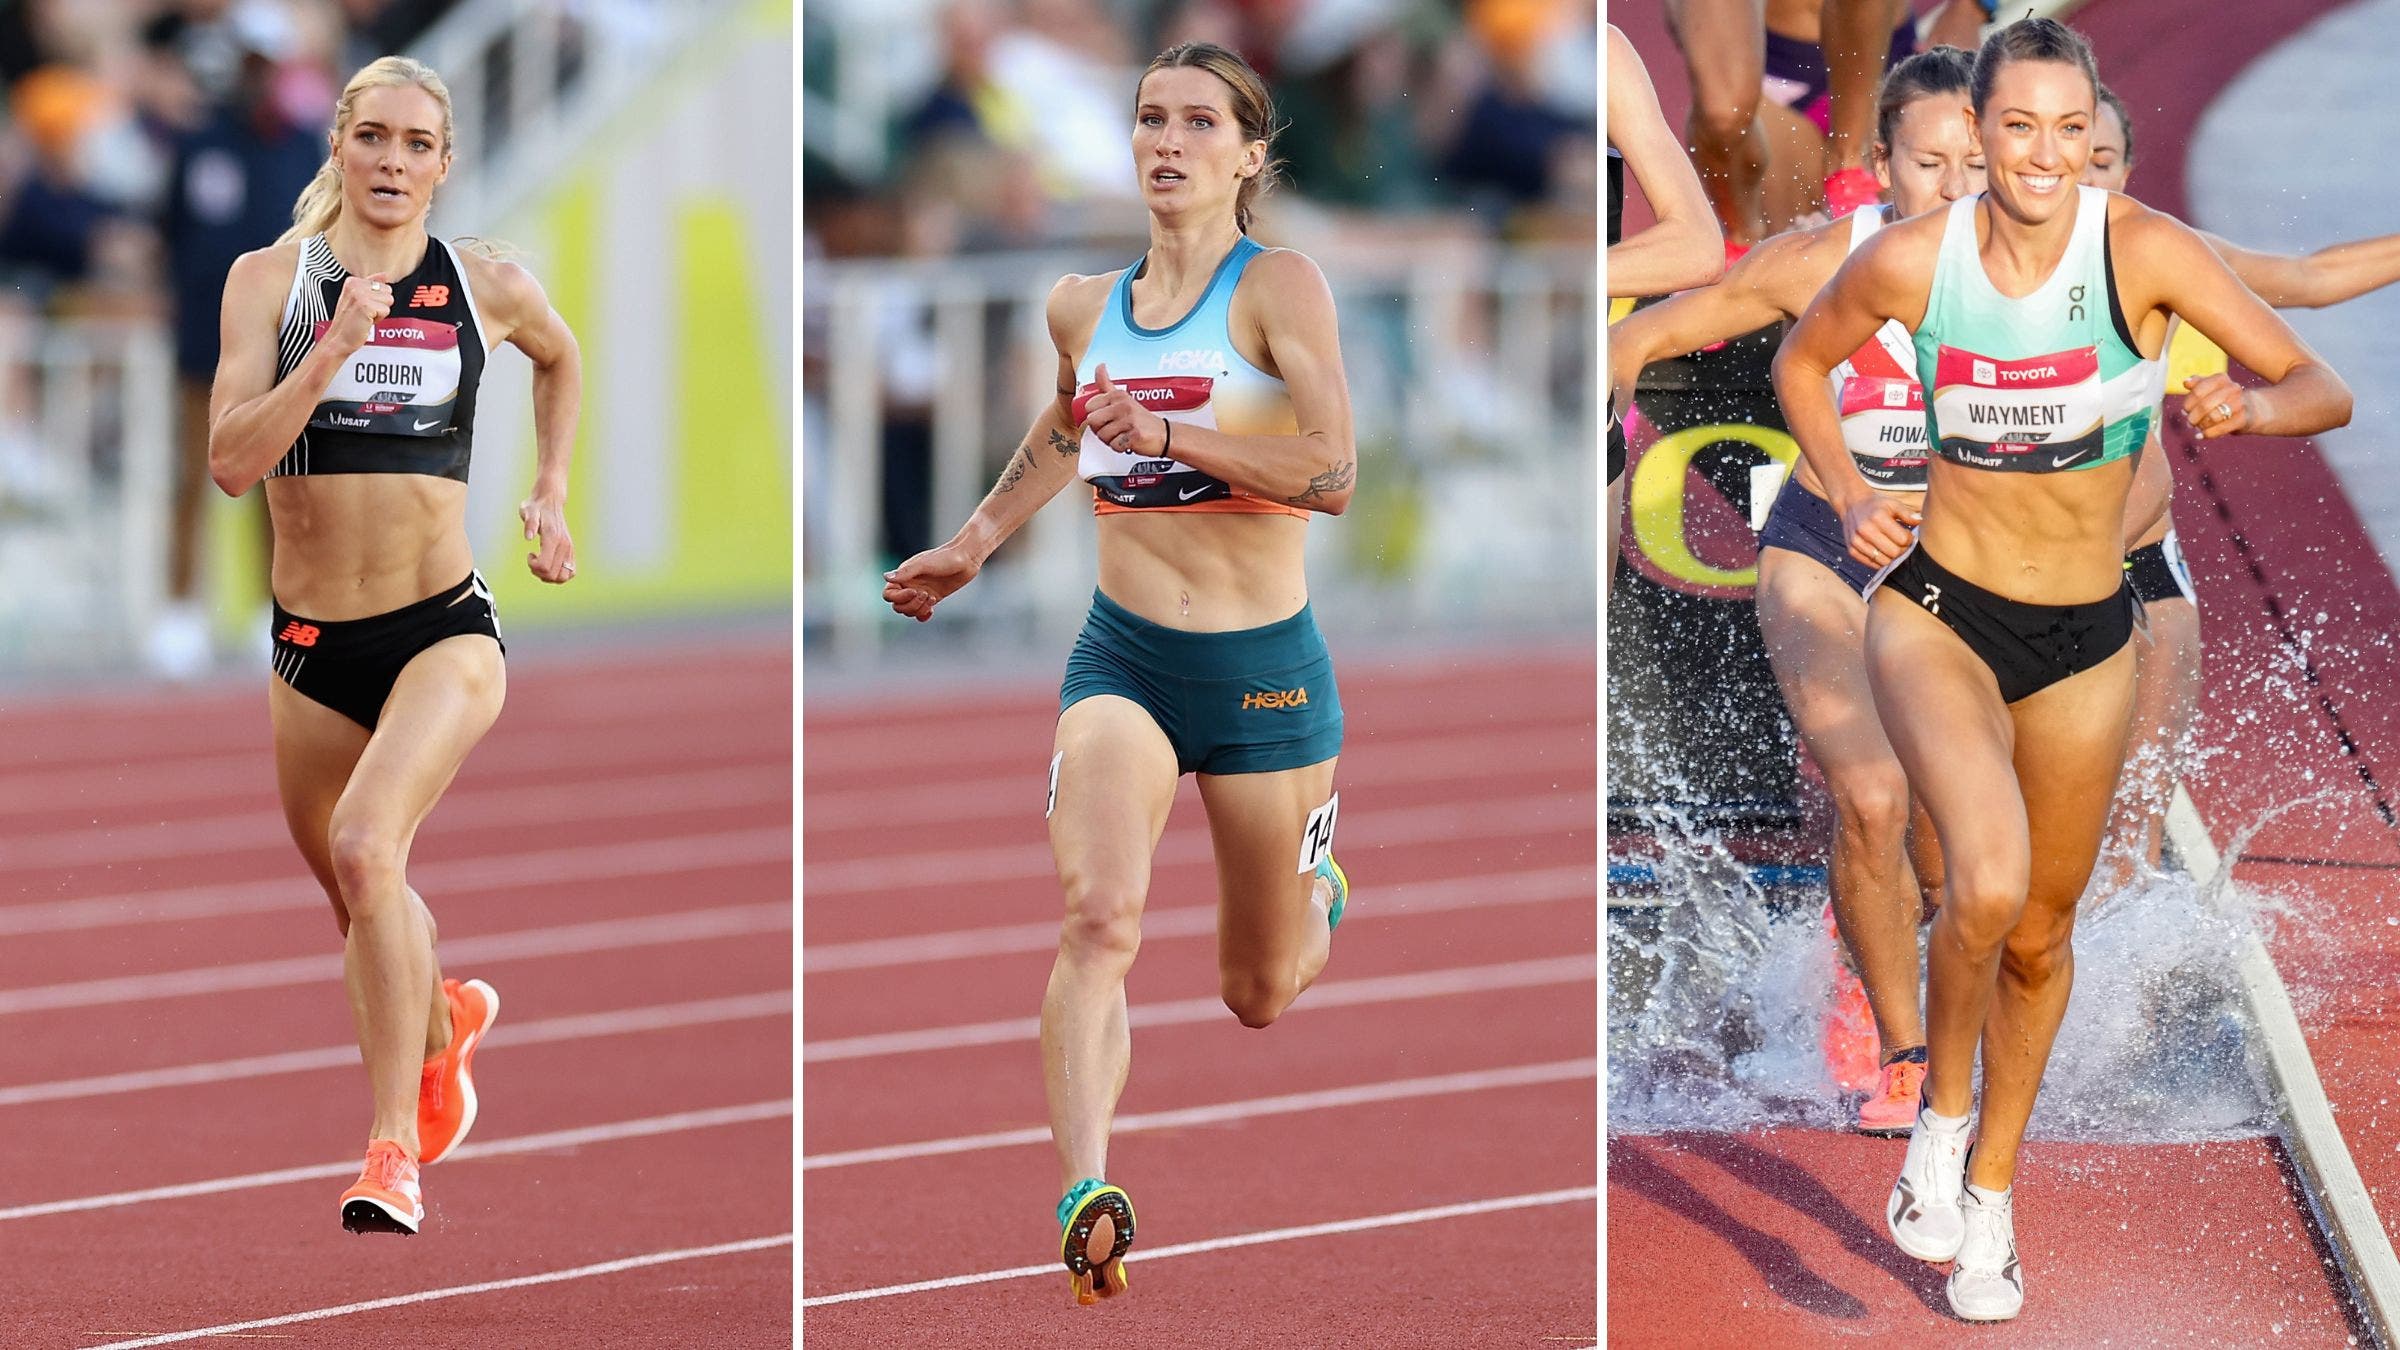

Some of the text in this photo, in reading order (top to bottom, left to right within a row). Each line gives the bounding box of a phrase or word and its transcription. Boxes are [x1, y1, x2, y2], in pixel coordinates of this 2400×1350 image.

[409, 284, 450, 307] NB
[379, 328, 425, 341] TOYOTA
[1158, 350, 1227, 371] HOKA
[355, 362, 423, 386] COBURN
[2000, 367, 2058, 381] TOYOTA
[1130, 388, 1175, 400] TOYOTA
[341, 417, 371, 427] USATF
[1968, 403, 2066, 426] WAYMENT
[1971, 456, 2003, 467] USATF
[278, 620, 321, 647] NB
[1242, 687, 1309, 710] HOKA
[1308, 804, 1334, 865] 14
